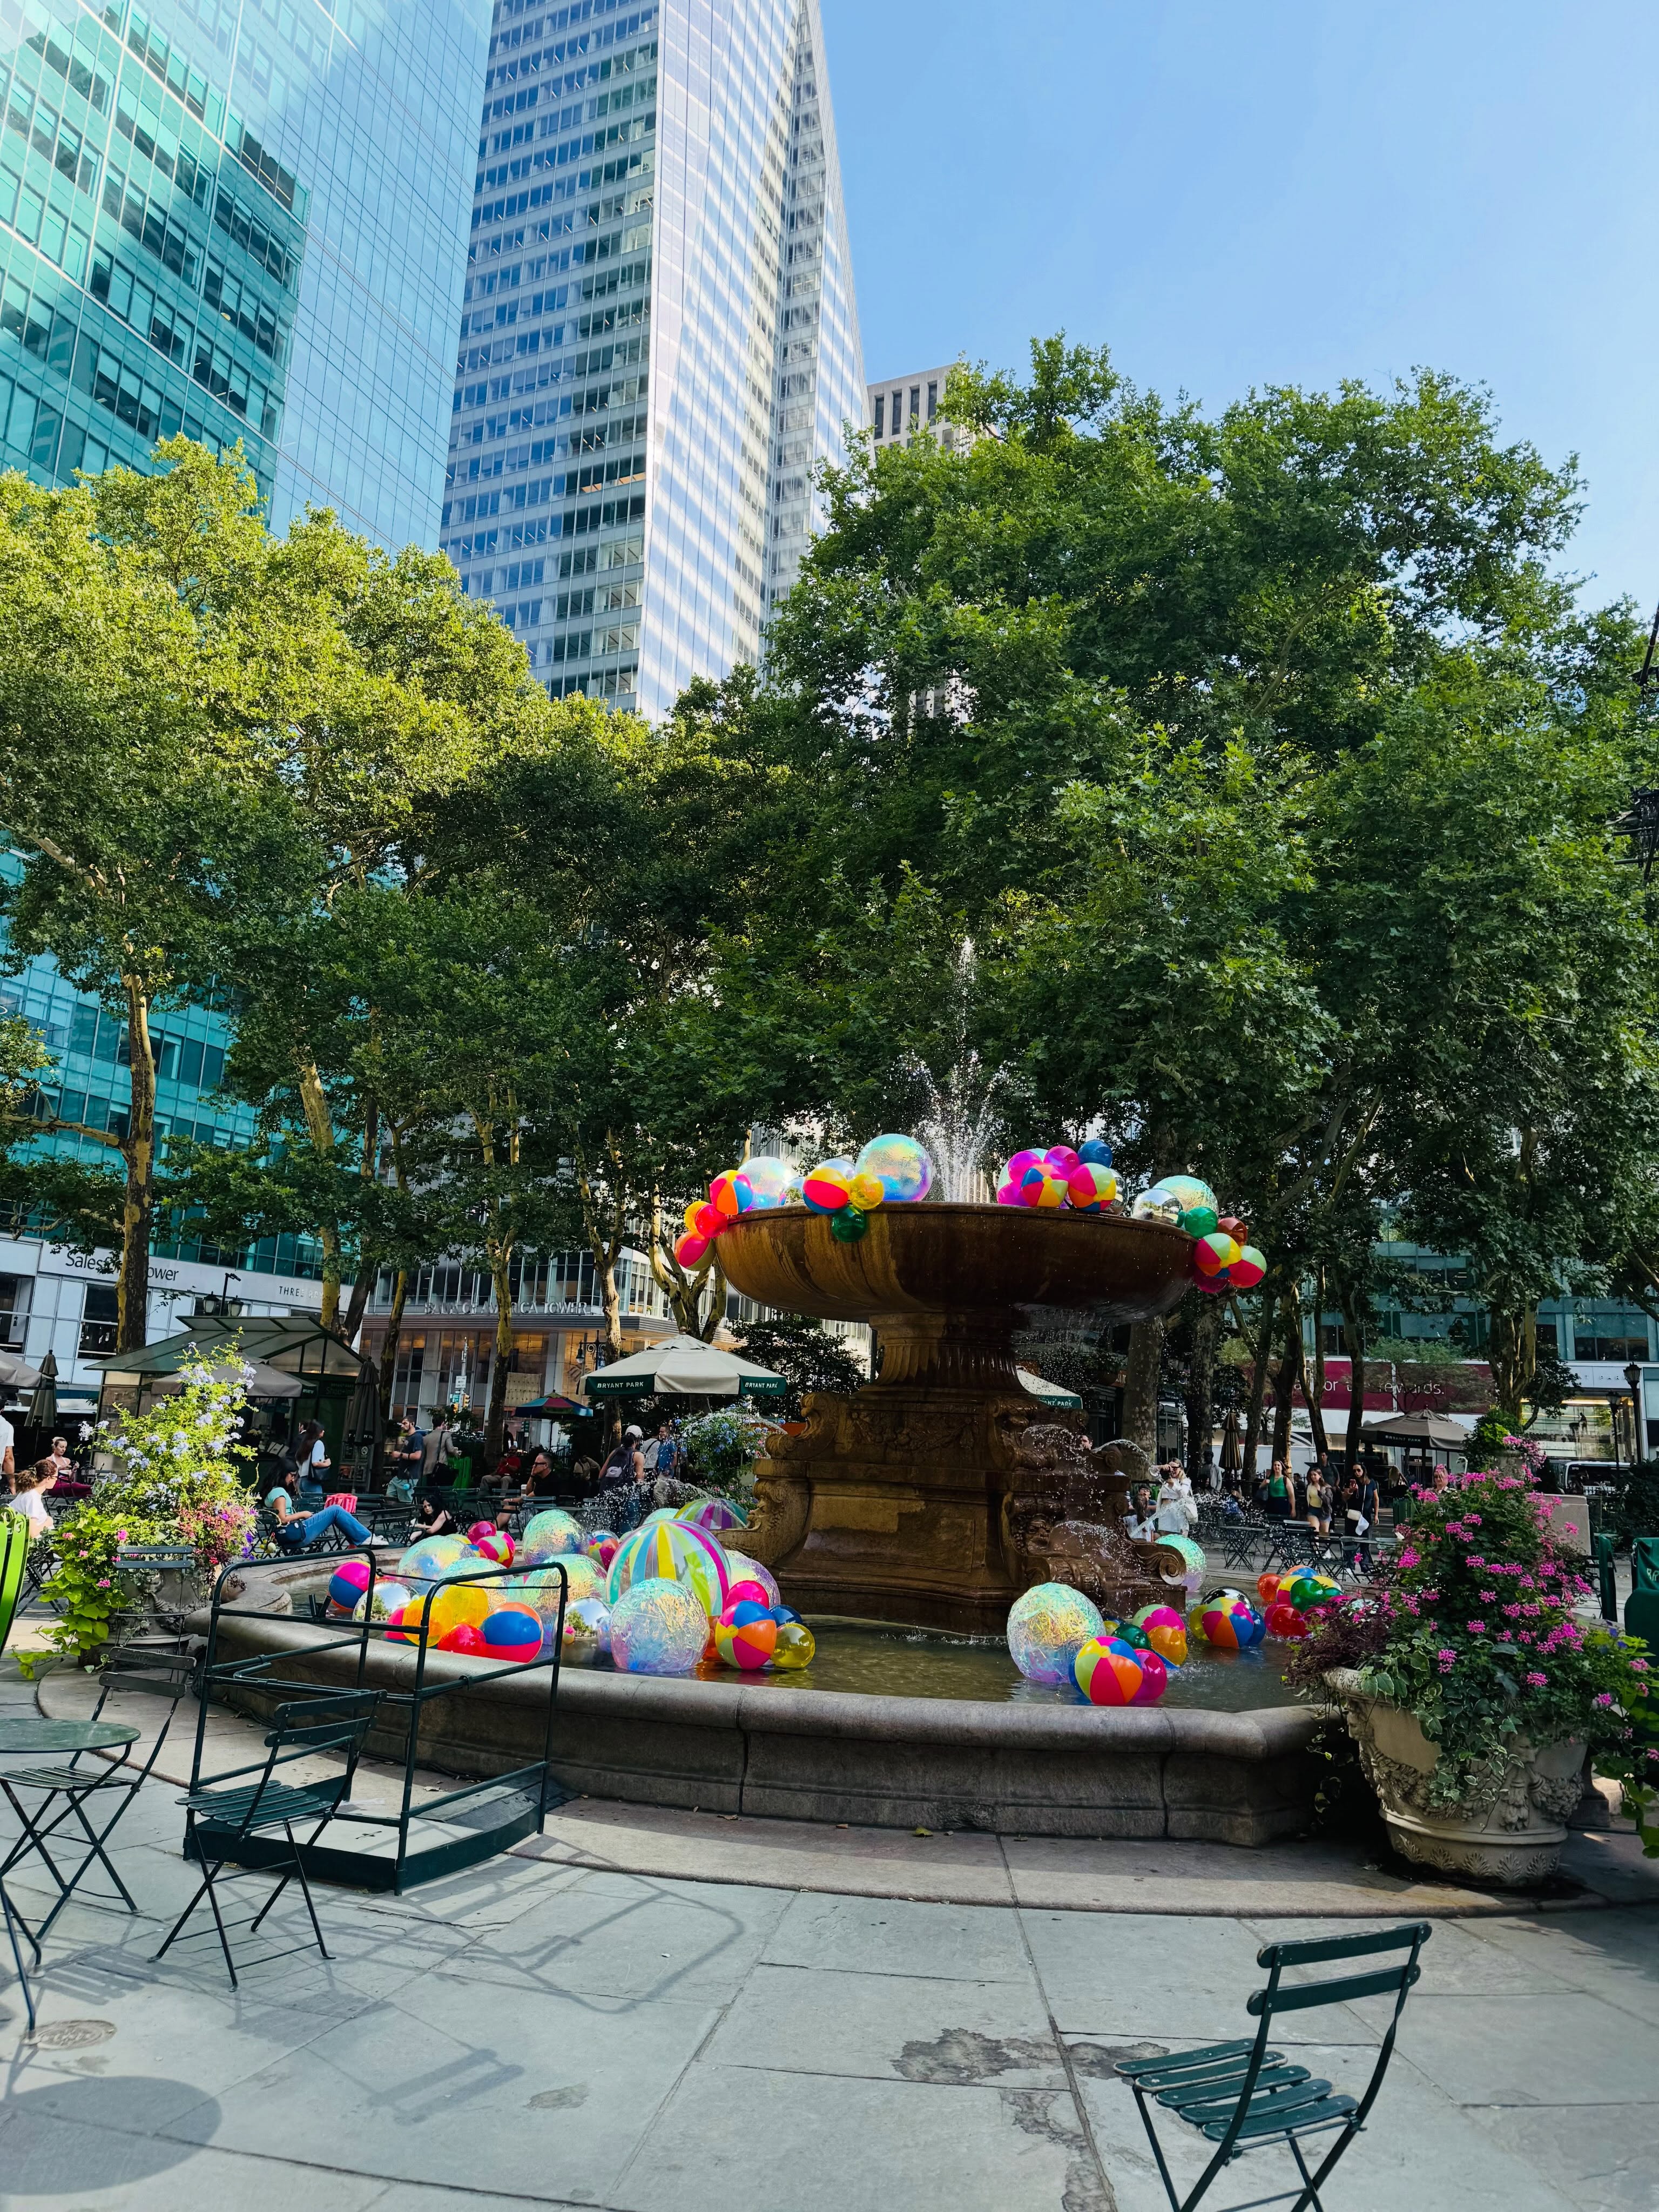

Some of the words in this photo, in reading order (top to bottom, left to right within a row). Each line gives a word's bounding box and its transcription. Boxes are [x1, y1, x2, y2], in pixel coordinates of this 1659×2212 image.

[146, 1266, 179, 1282] ower
[279, 1286, 304, 1297] THREE
[542, 1301, 588, 1314] TOWER
[1324, 1381, 1339, 1391] or
[1379, 1380, 1445, 1394] rewards.
